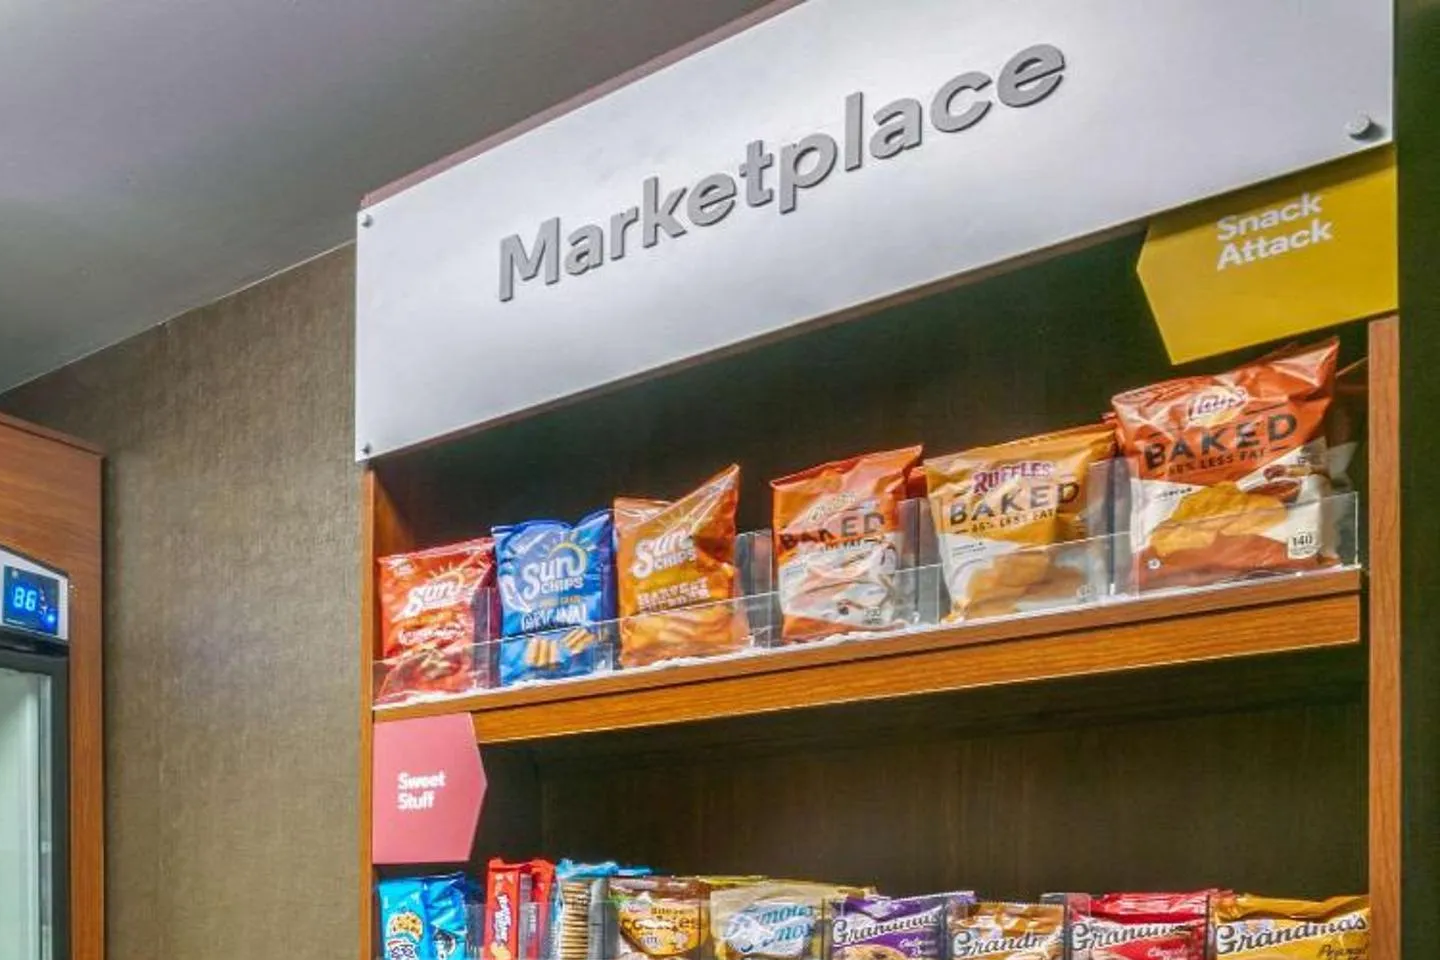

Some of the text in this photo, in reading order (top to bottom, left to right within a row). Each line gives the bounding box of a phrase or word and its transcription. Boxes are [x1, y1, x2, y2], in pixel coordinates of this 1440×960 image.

[498, 42, 1066, 301] Marketplace
[1217, 193, 1323, 241] Snack
[1216, 219, 1334, 271] Attack
[1145, 413, 1298, 470] BAKED
[973, 462, 1053, 494] RUFFLES
[950, 482, 1080, 526] BAKED
[632, 529, 692, 578] Sun
[522, 553, 584, 600] Sun
[541, 576, 585, 594] CHIPS
[397, 770, 447, 790] Sweet
[397, 791, 435, 810] Stuff
[1217, 913, 1367, 955] Grandma's
